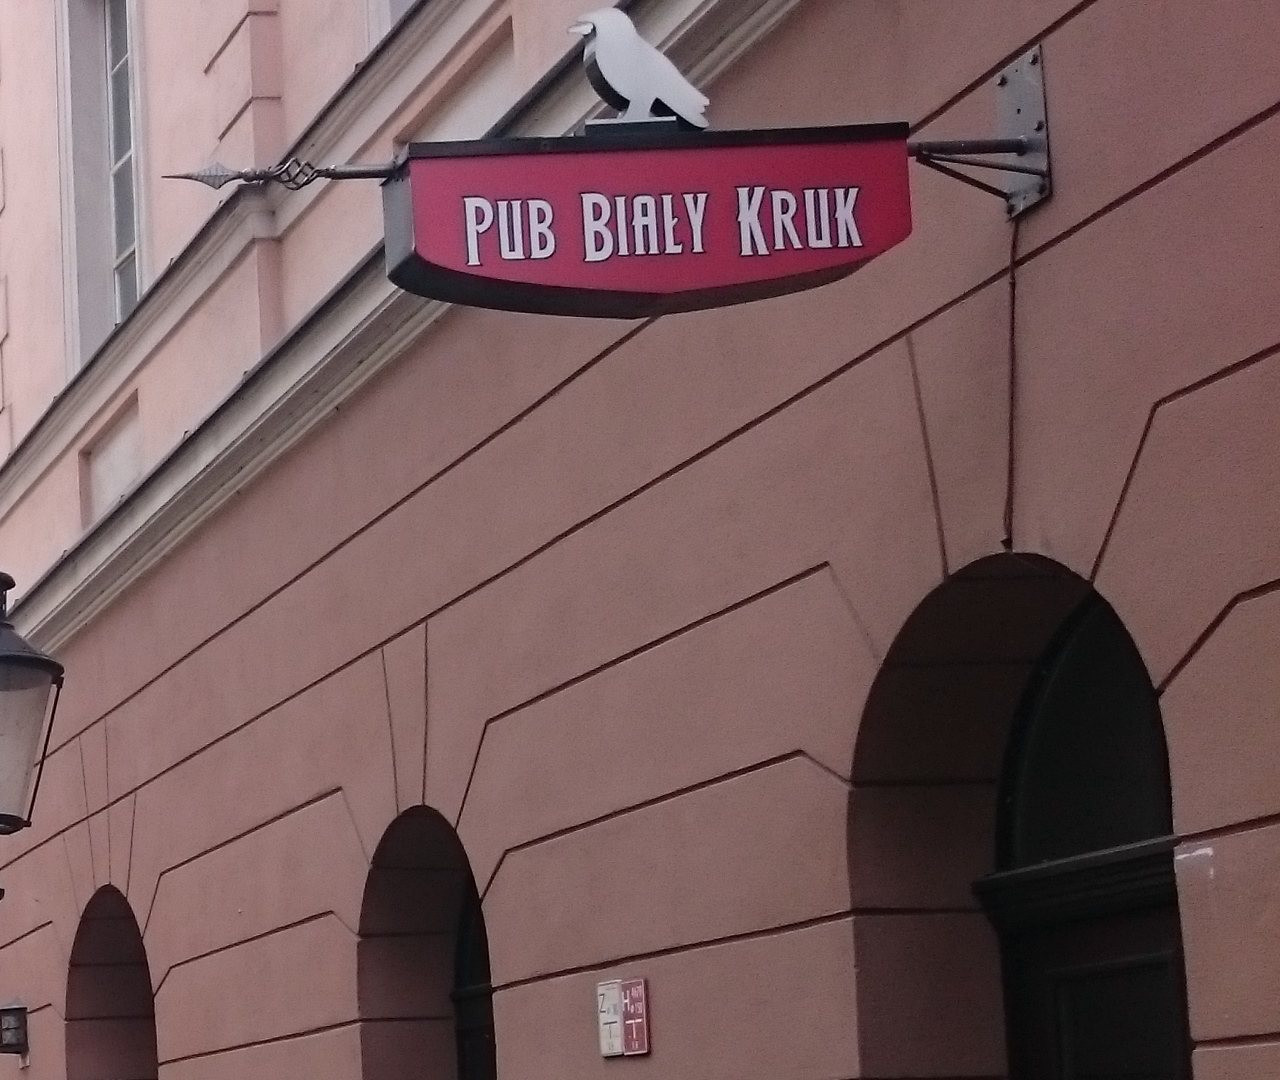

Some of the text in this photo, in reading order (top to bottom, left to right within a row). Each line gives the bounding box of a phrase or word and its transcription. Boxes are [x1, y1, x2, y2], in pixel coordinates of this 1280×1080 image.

[463, 185, 864, 267] PUB BIAŁY KRUK
